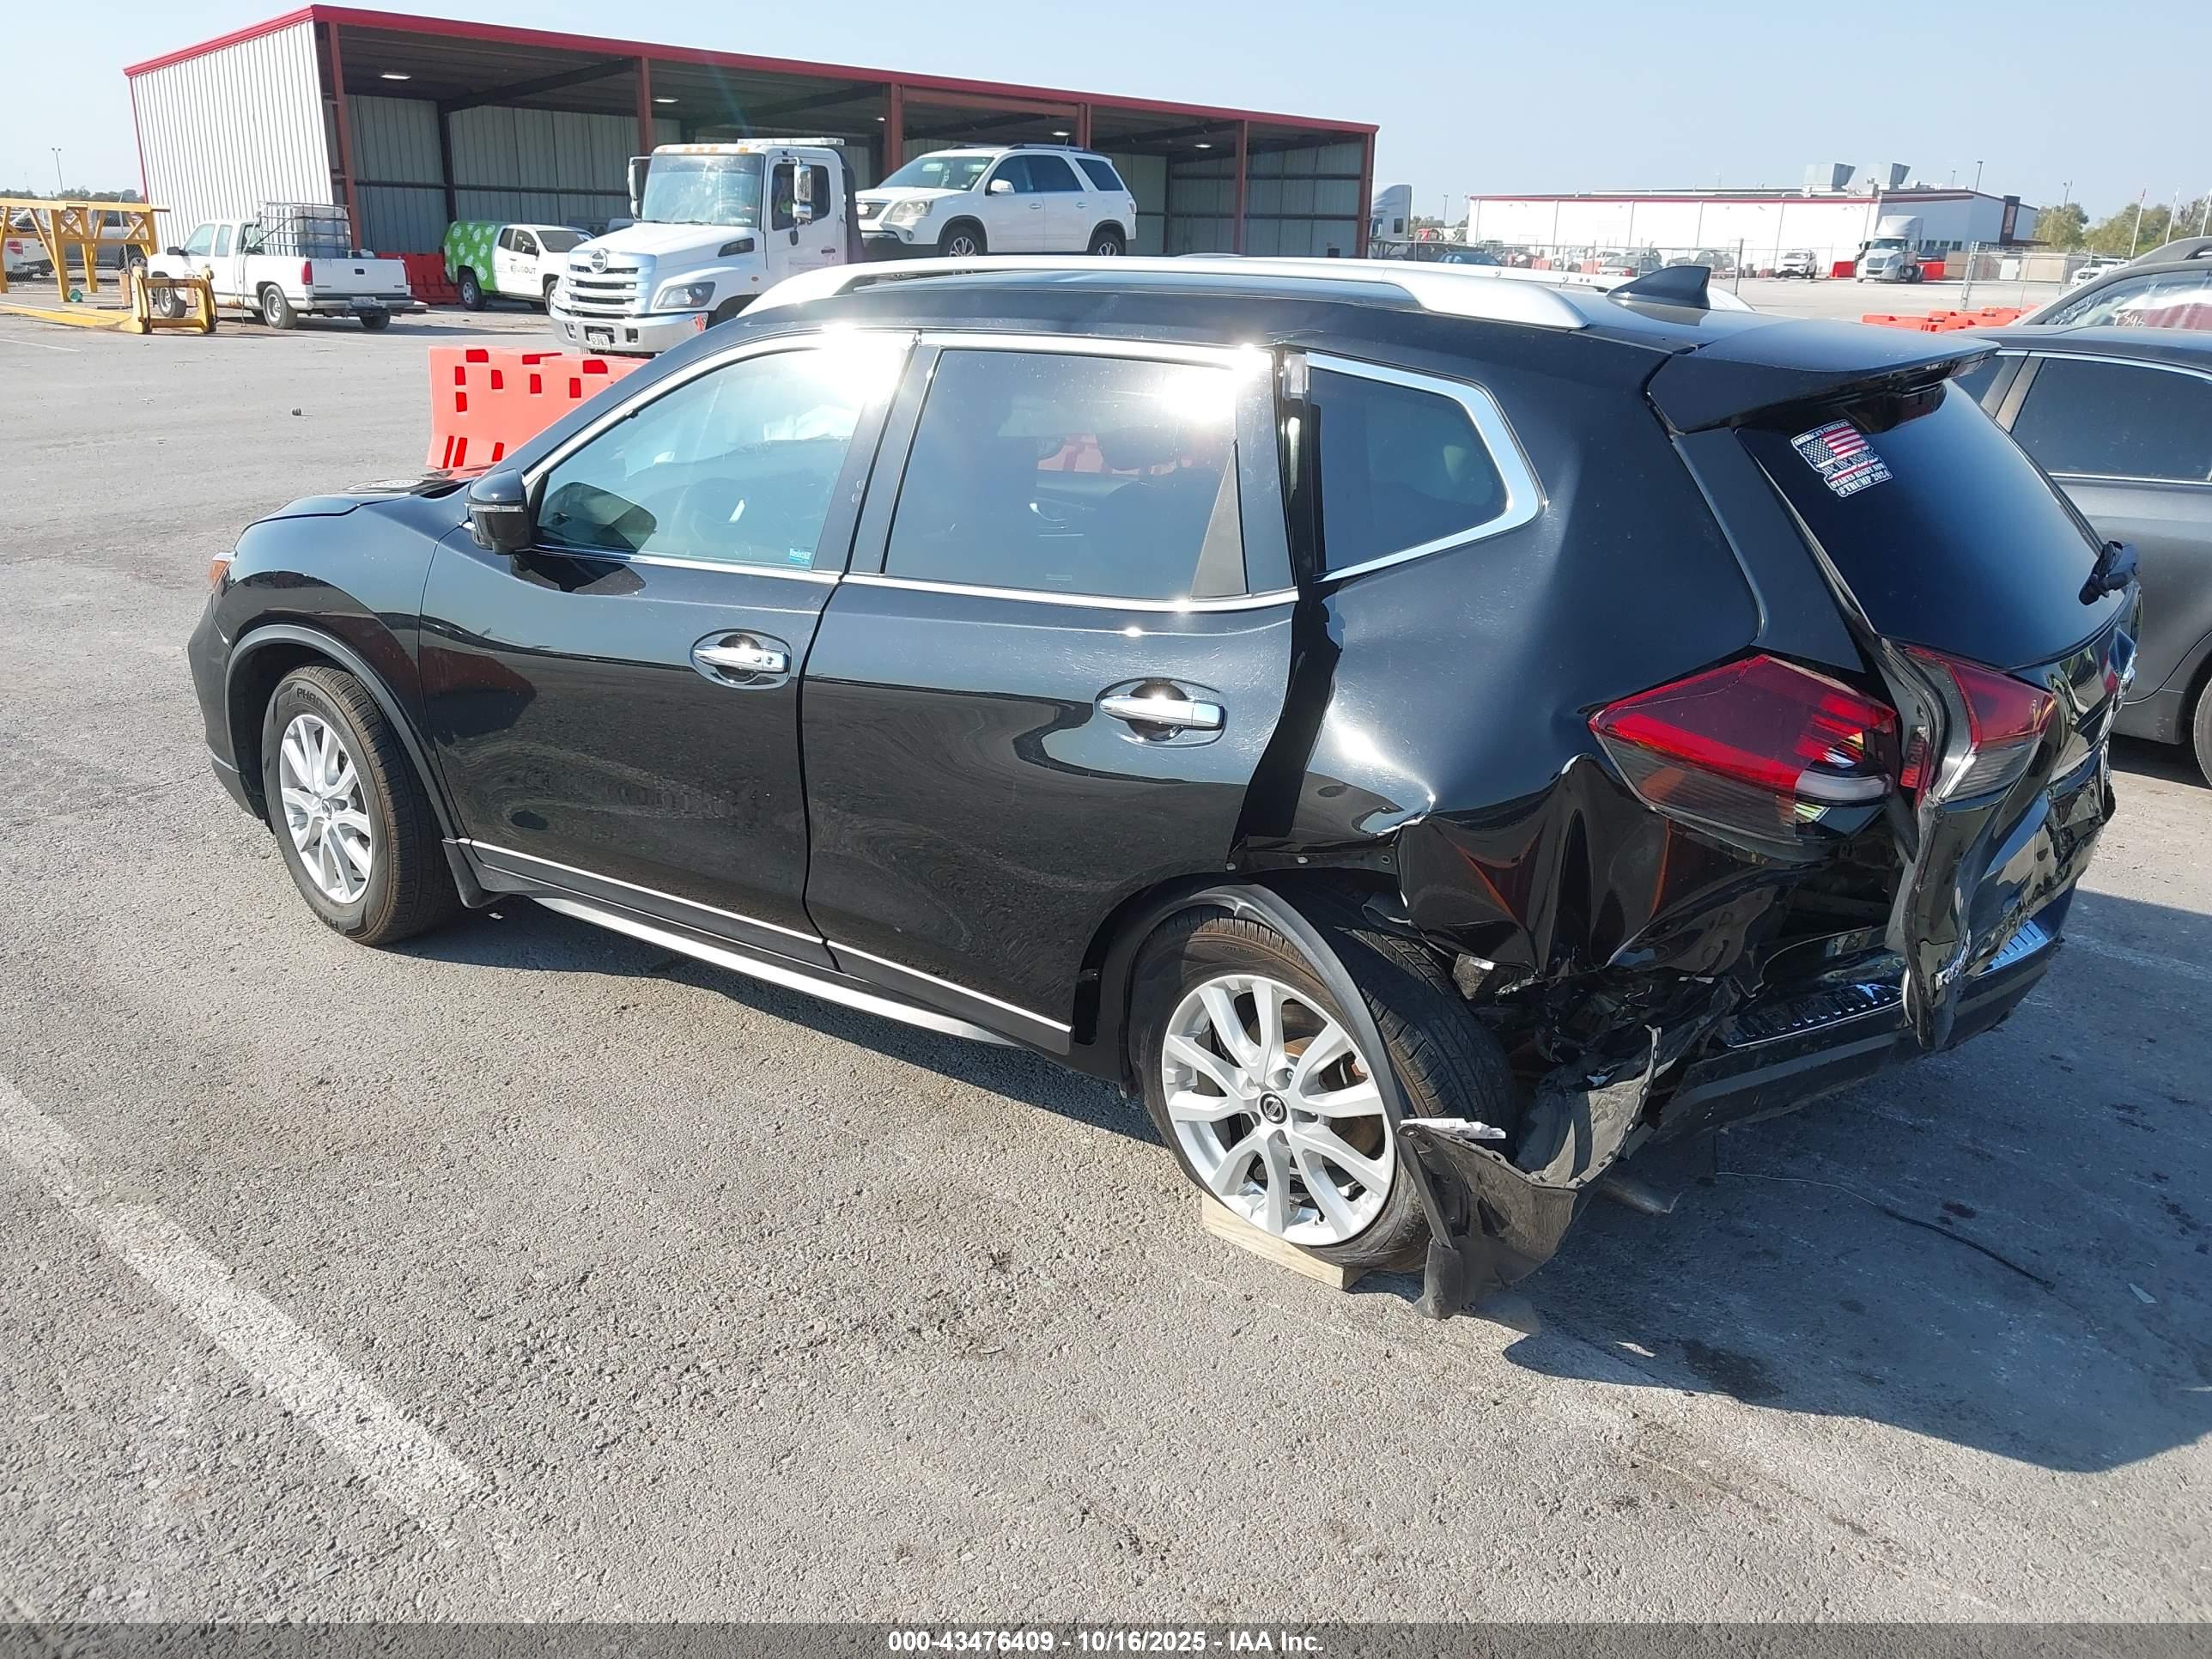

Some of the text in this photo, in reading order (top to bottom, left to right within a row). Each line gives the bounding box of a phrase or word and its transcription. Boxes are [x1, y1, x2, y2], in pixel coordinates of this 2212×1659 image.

[1830, 473, 1856, 489] STARTS
[1854, 466, 1875, 478] RIGHT
[1870, 470, 1891, 482] 2024
